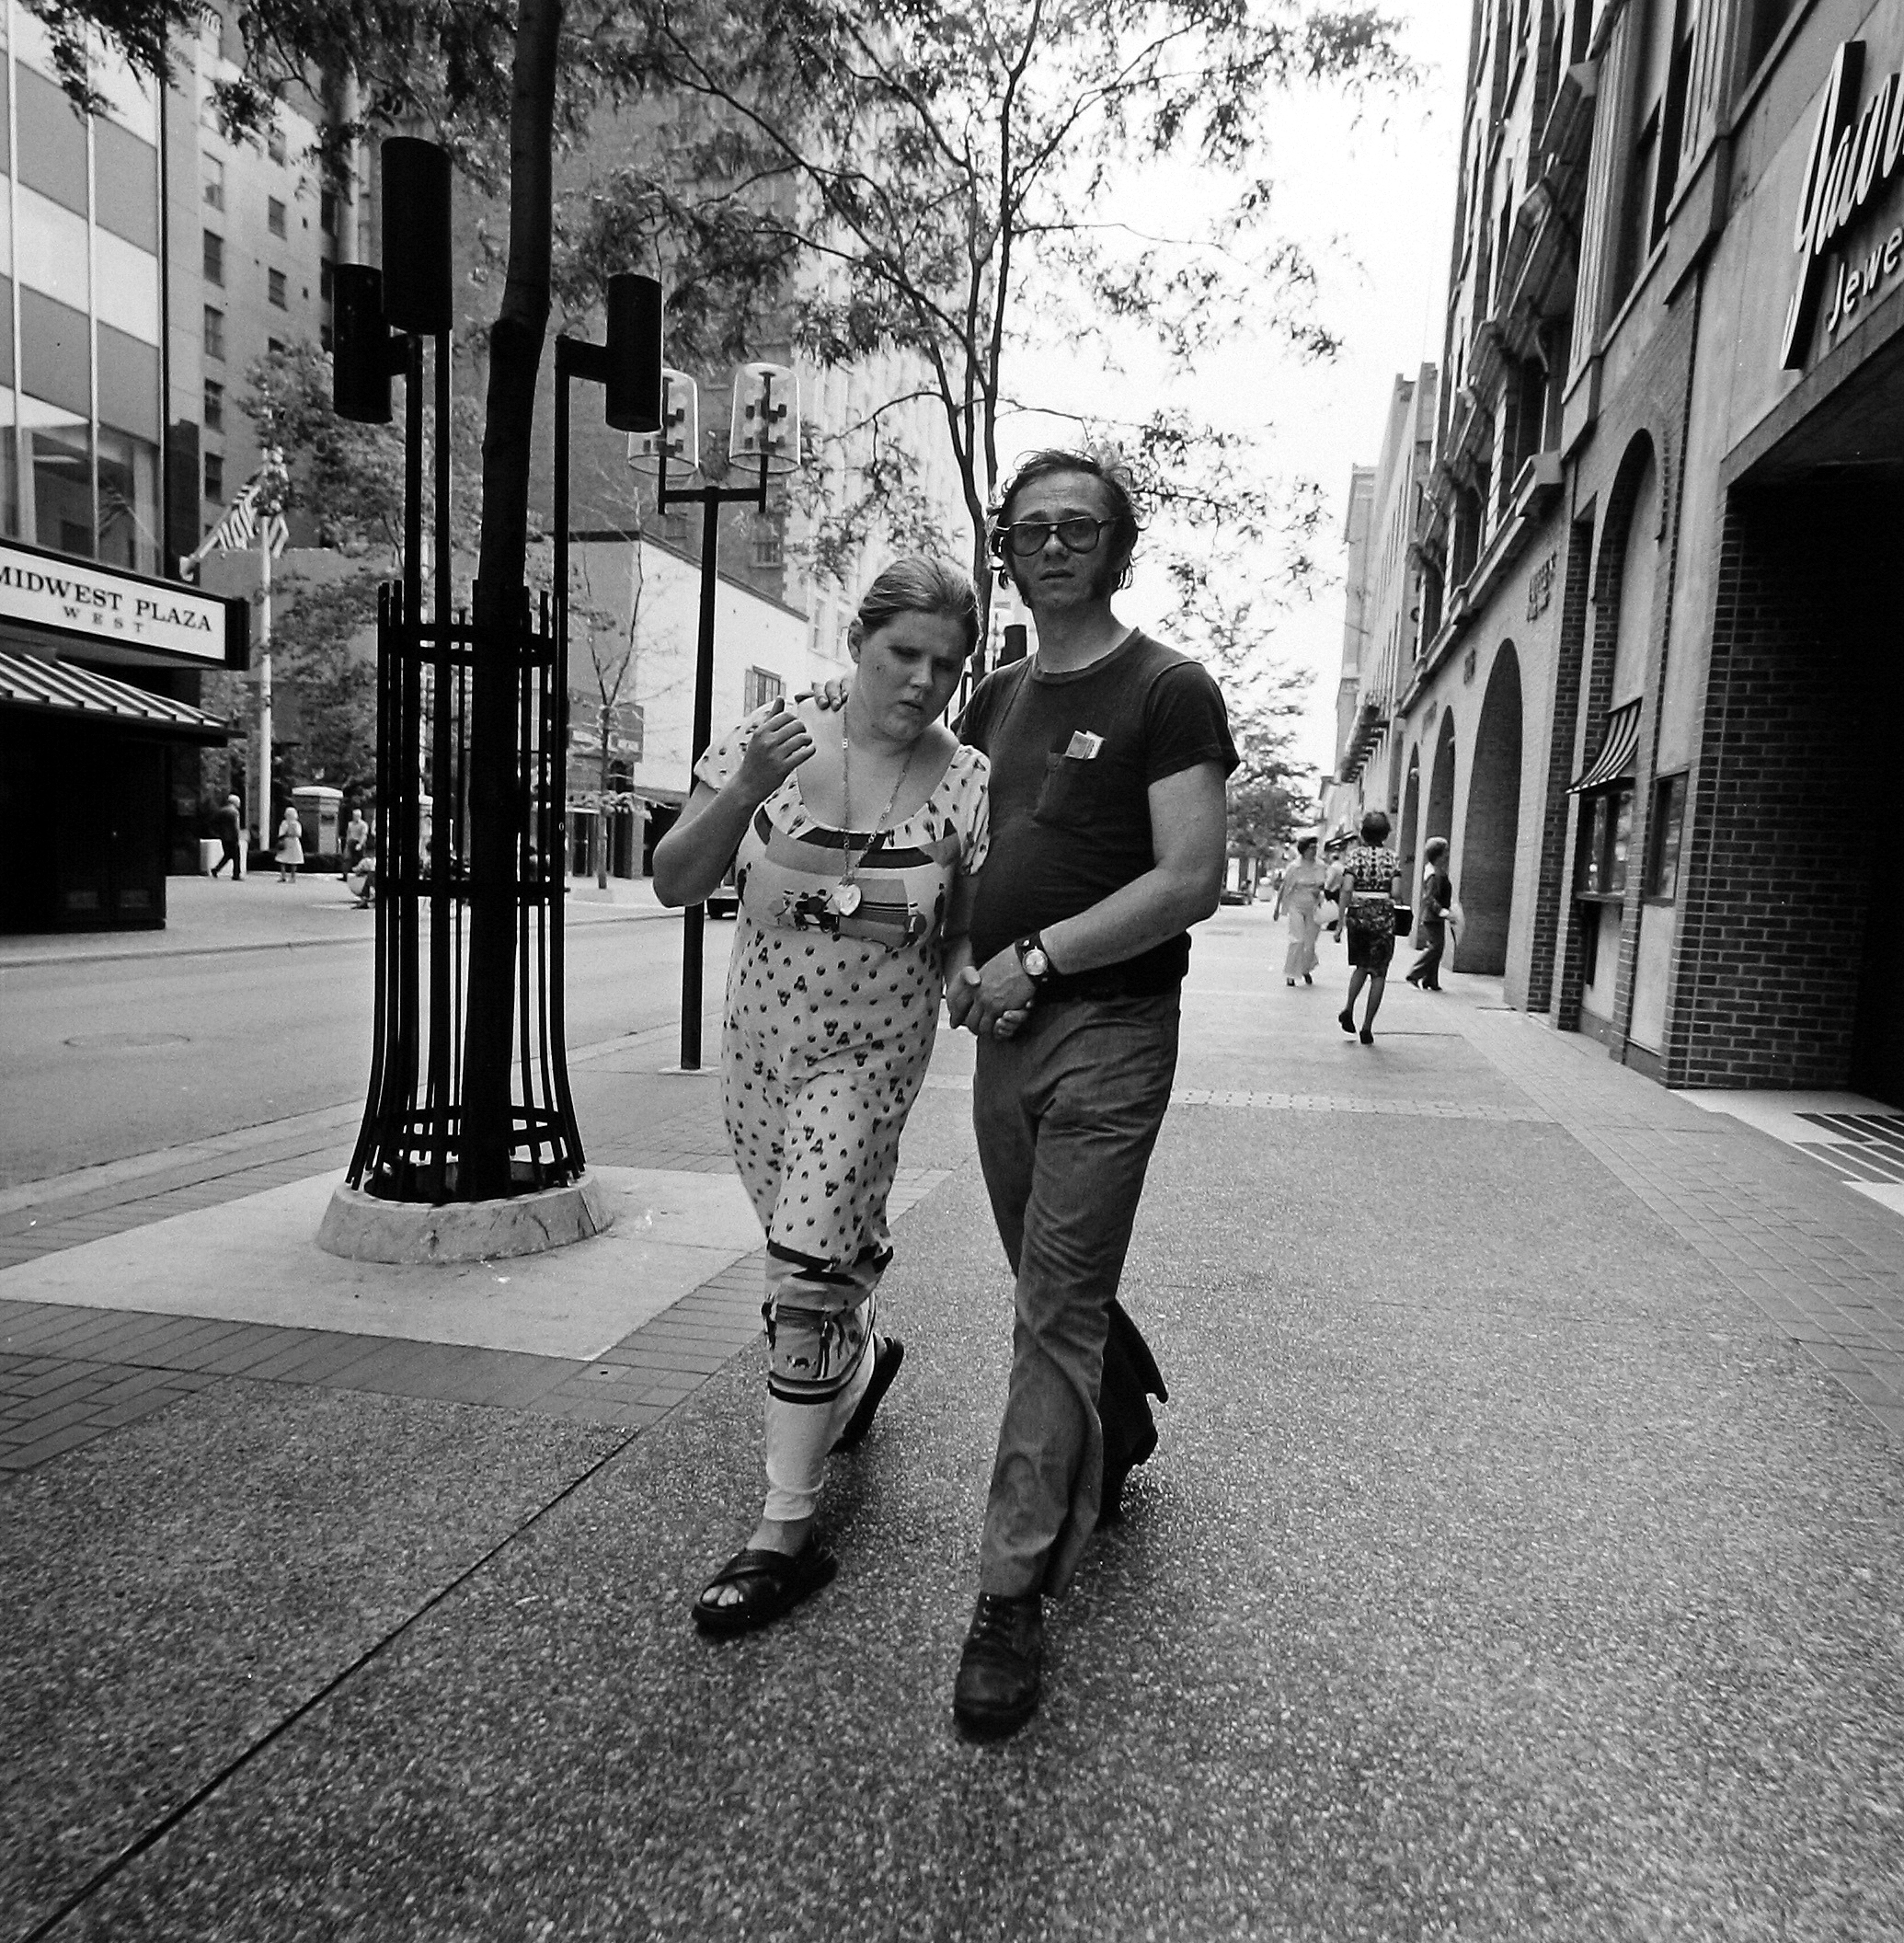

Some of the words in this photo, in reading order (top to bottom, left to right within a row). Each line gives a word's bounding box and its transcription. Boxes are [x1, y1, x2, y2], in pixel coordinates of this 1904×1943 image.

[1827, 226, 1903, 332] Jewe
[63, 605, 143, 633] WEST
[136, 599, 212, 632] PLAZA
